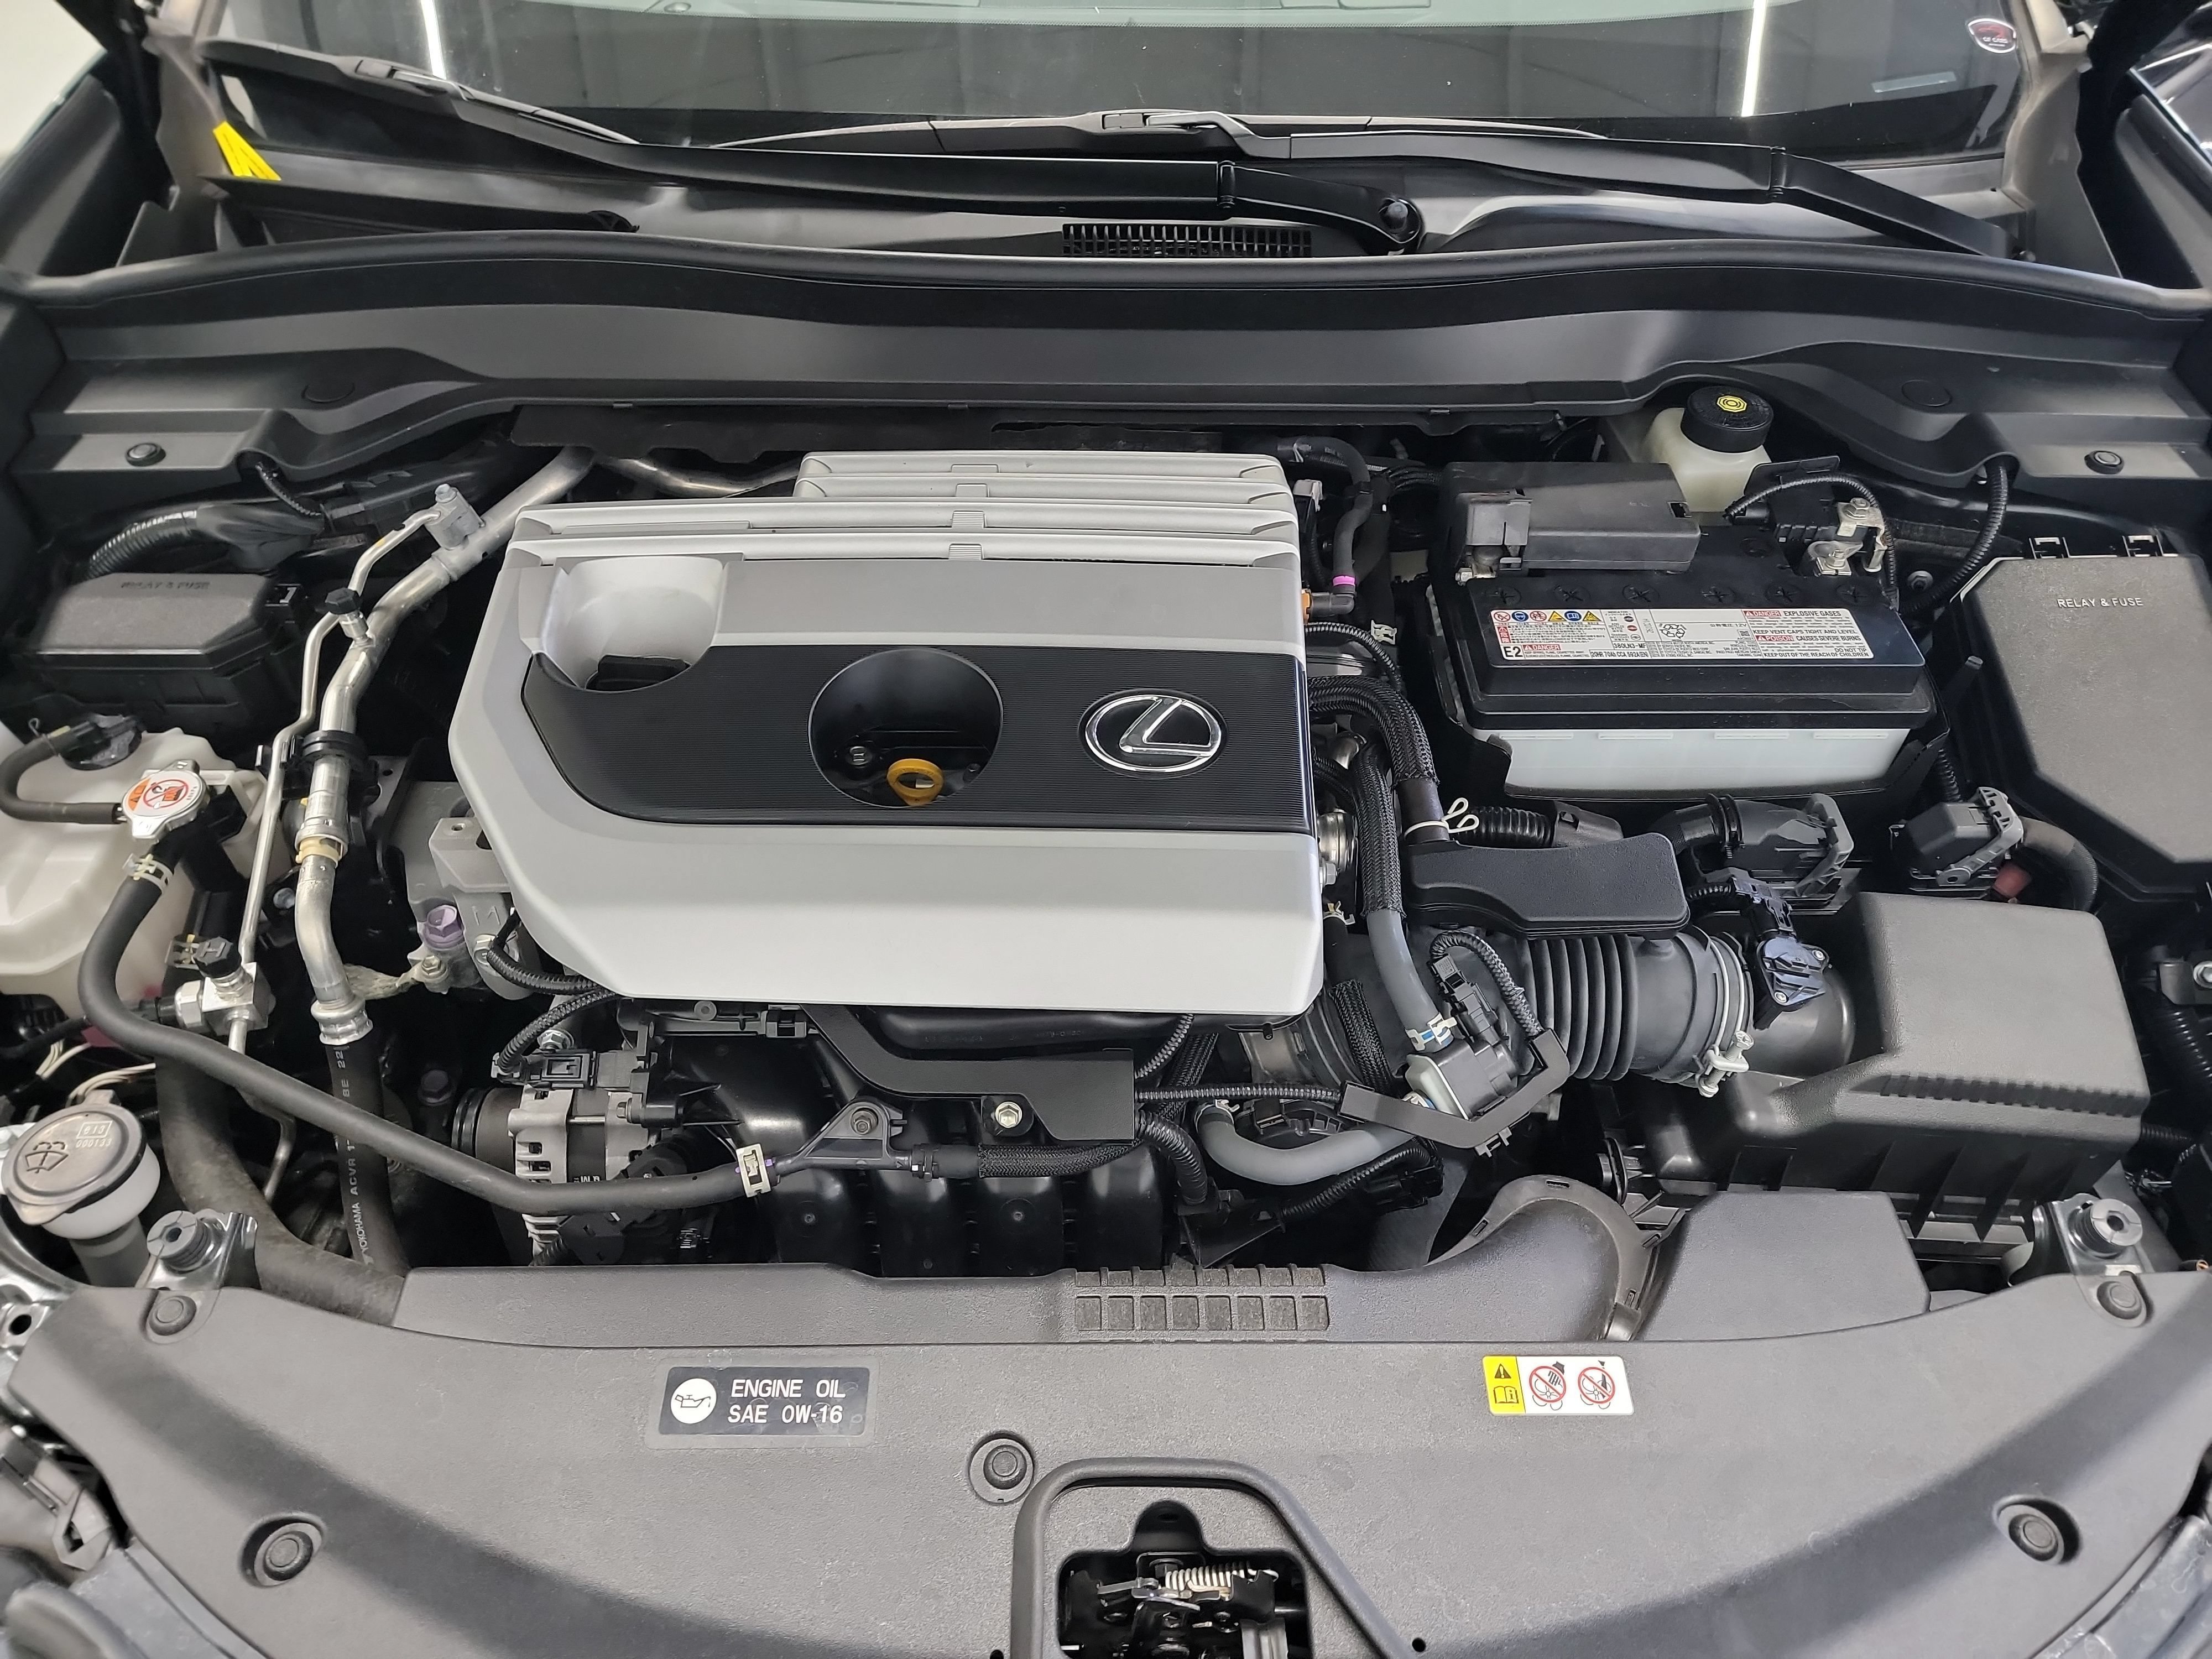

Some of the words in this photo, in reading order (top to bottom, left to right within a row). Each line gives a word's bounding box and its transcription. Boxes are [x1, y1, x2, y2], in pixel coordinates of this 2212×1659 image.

[2057, 598, 2095, 608] RELAY
[2101, 598, 2109, 607] &
[2112, 598, 2143, 607] FUSE
[1503, 646, 1523, 658] E2
[200, 941, 226, 958] H
[76, 1138, 111, 1149] 000133
[348, 1159, 358, 1196] ACVR
[352, 1202, 369, 1253] YOKOHAMA
[731, 1379, 804, 1398] ENGINE
[816, 1379, 846, 1399] OIL
[728, 1405, 769, 1424] SAE
[781, 1405, 843, 1424] 0W-16
